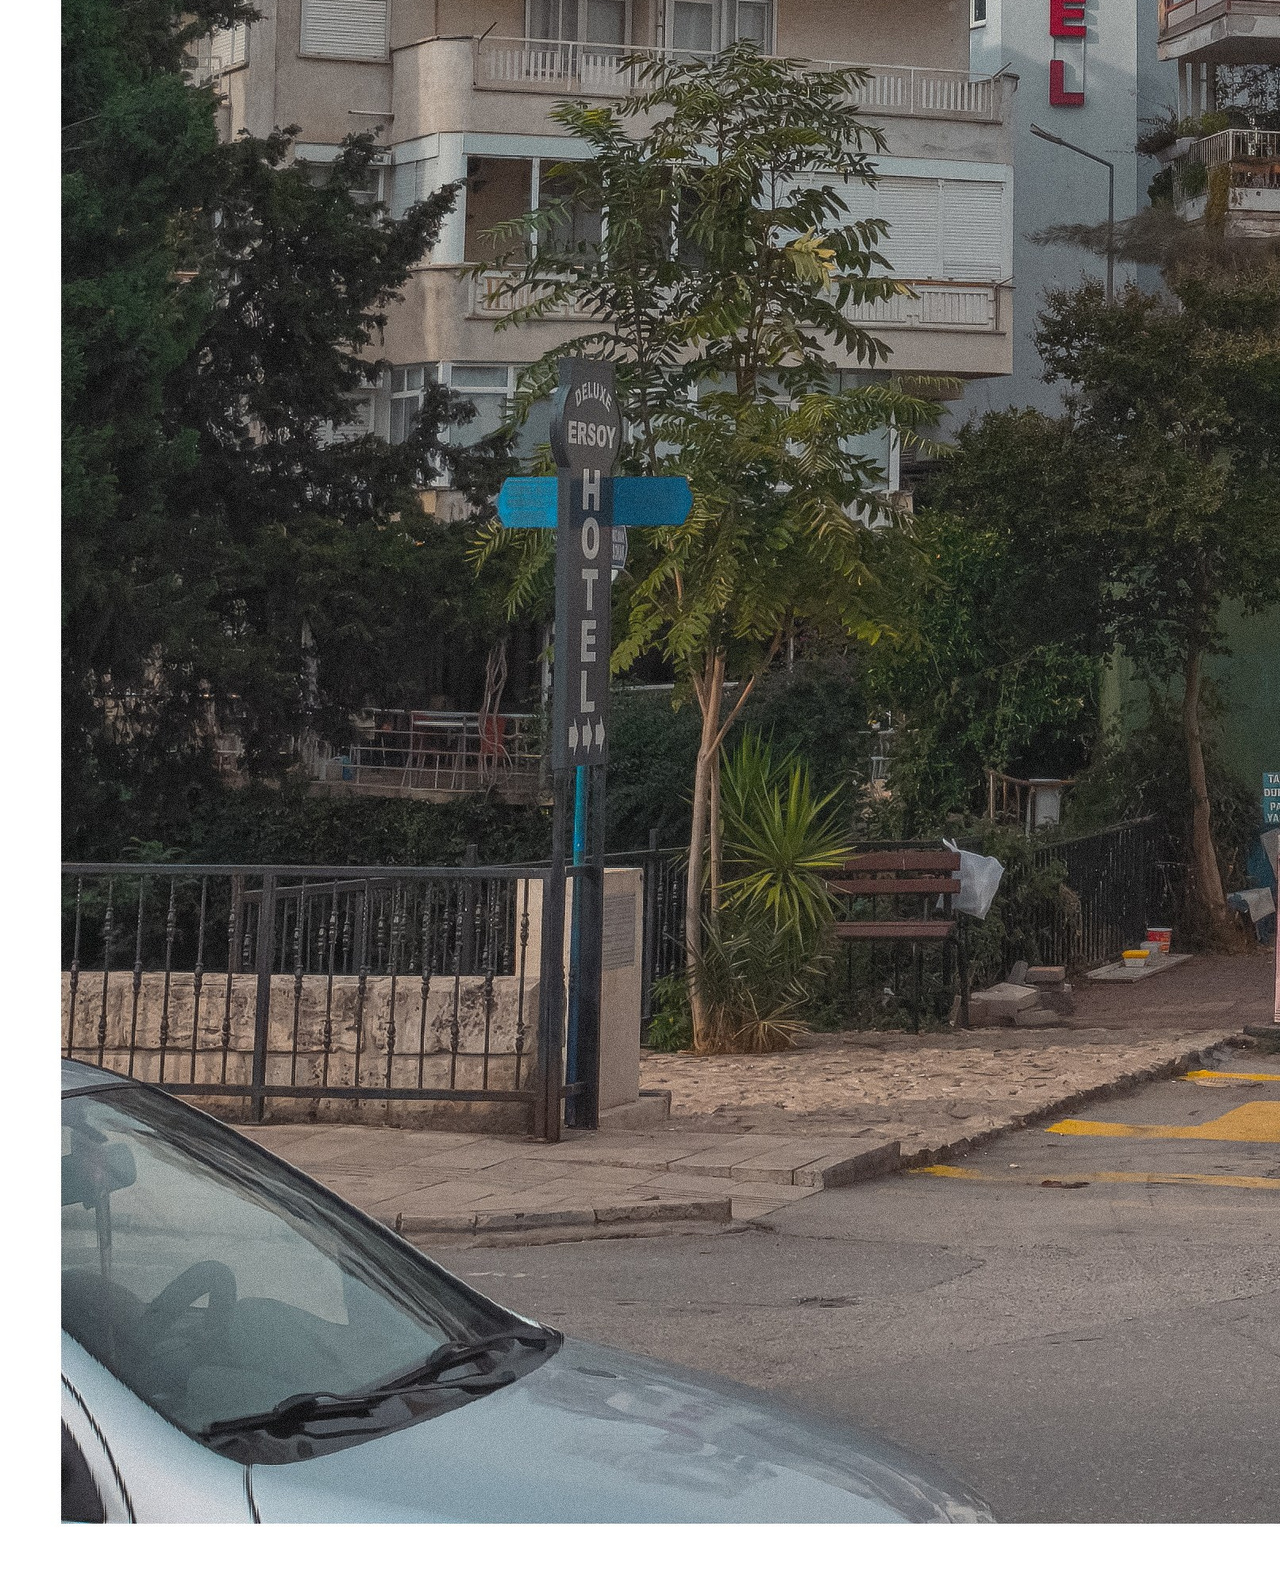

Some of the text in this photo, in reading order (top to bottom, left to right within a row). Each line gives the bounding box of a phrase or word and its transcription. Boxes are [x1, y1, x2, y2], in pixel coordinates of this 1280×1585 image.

[574, 382, 612, 412] DELUXE
[567, 420, 616, 449] ERSOY
[581, 468, 601, 713] HOTEL
